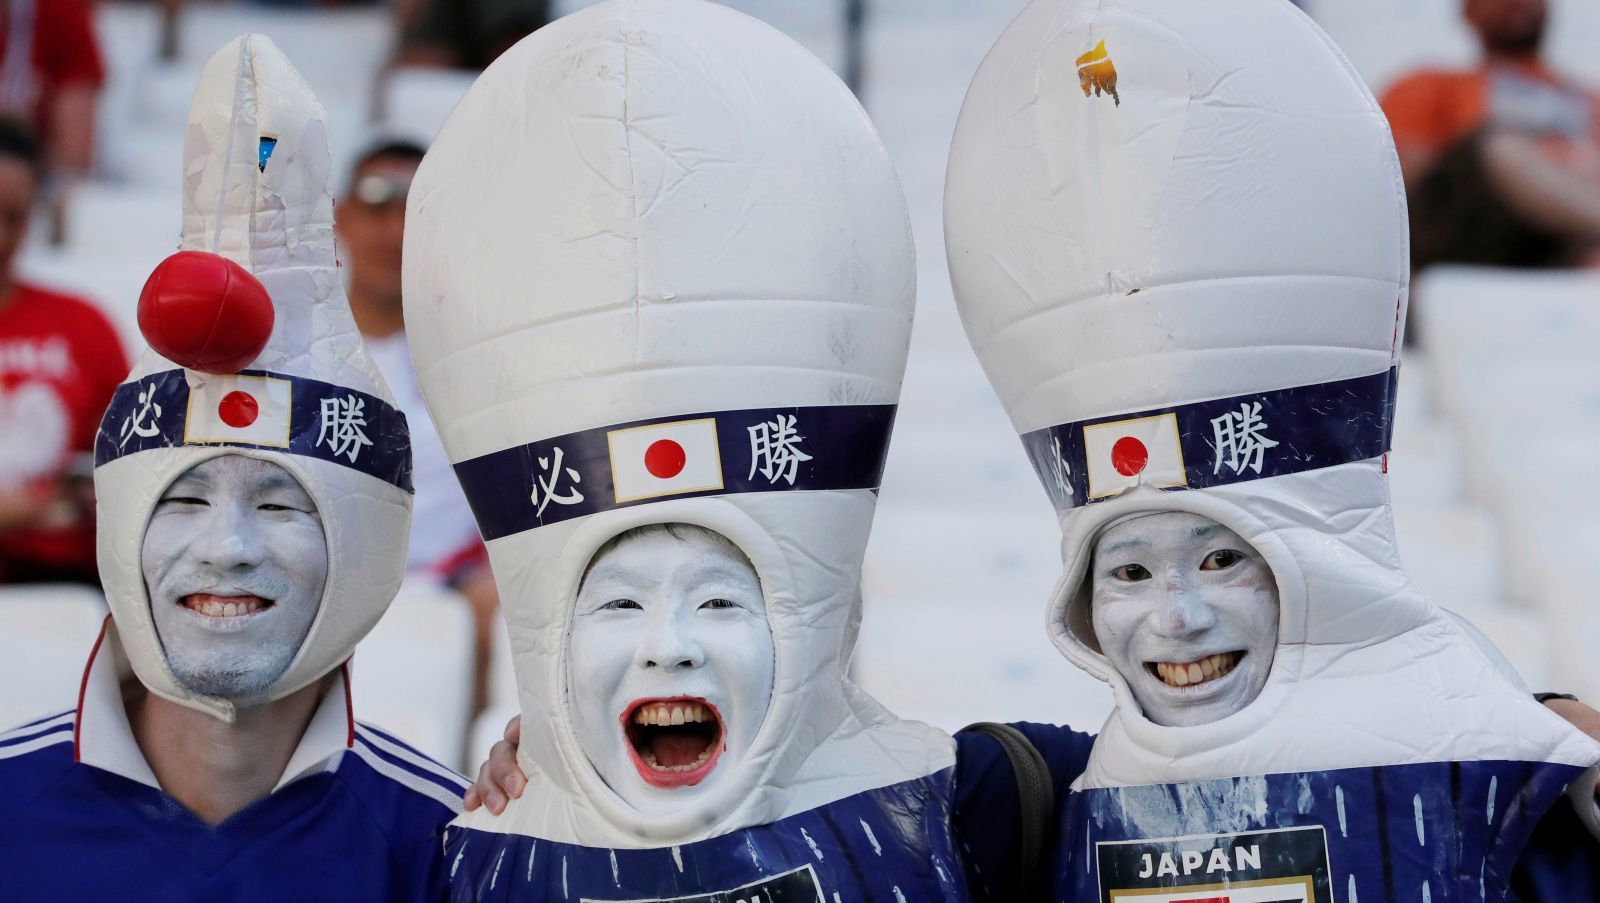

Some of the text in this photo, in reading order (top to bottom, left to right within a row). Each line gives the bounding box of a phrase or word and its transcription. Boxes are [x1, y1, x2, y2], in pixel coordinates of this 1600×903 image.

[120, 382, 374, 463] 必 勝
[1210, 402, 1279, 475] 勝
[530, 414, 813, 517] 必 勝
[1139, 844, 1262, 878] JAPAN
